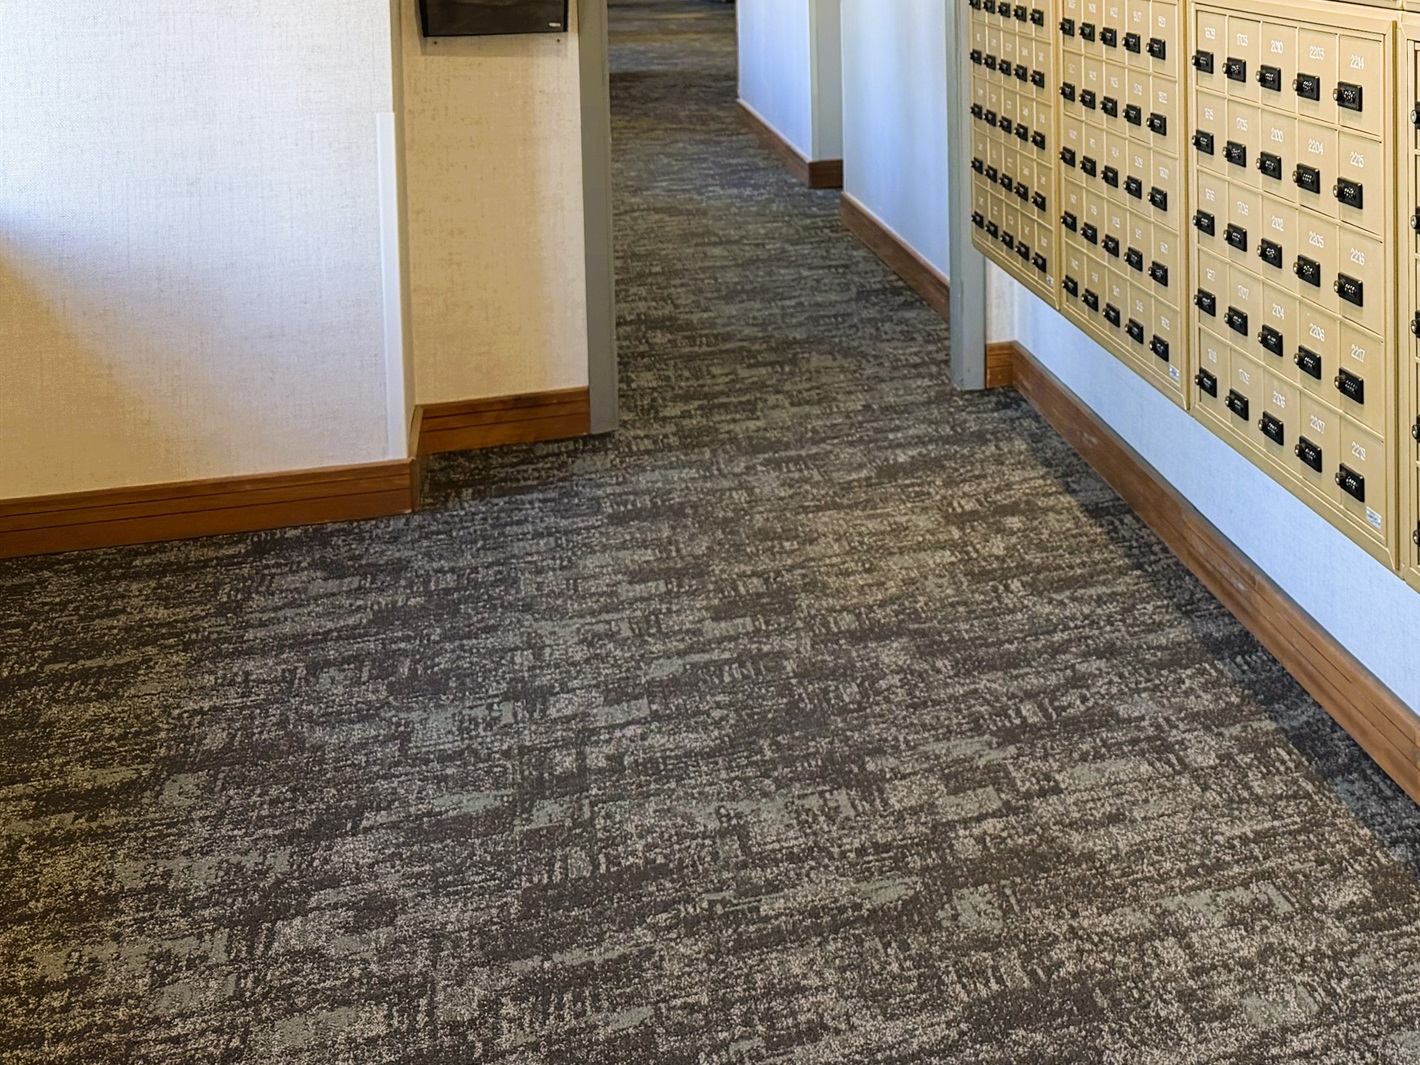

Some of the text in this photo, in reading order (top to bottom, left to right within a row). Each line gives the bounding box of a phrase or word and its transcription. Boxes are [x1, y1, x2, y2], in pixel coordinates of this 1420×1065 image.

[1309, 45, 1325, 61] 2203
[1349, 54, 1365, 70] 2214
[1308, 138, 1324, 155] 2204
[1349, 151, 1365, 168] 2215
[1308, 231, 1324, 249] 2205
[1350, 247, 1365, 266] 2216
[1309, 322, 1325, 342] 2206
